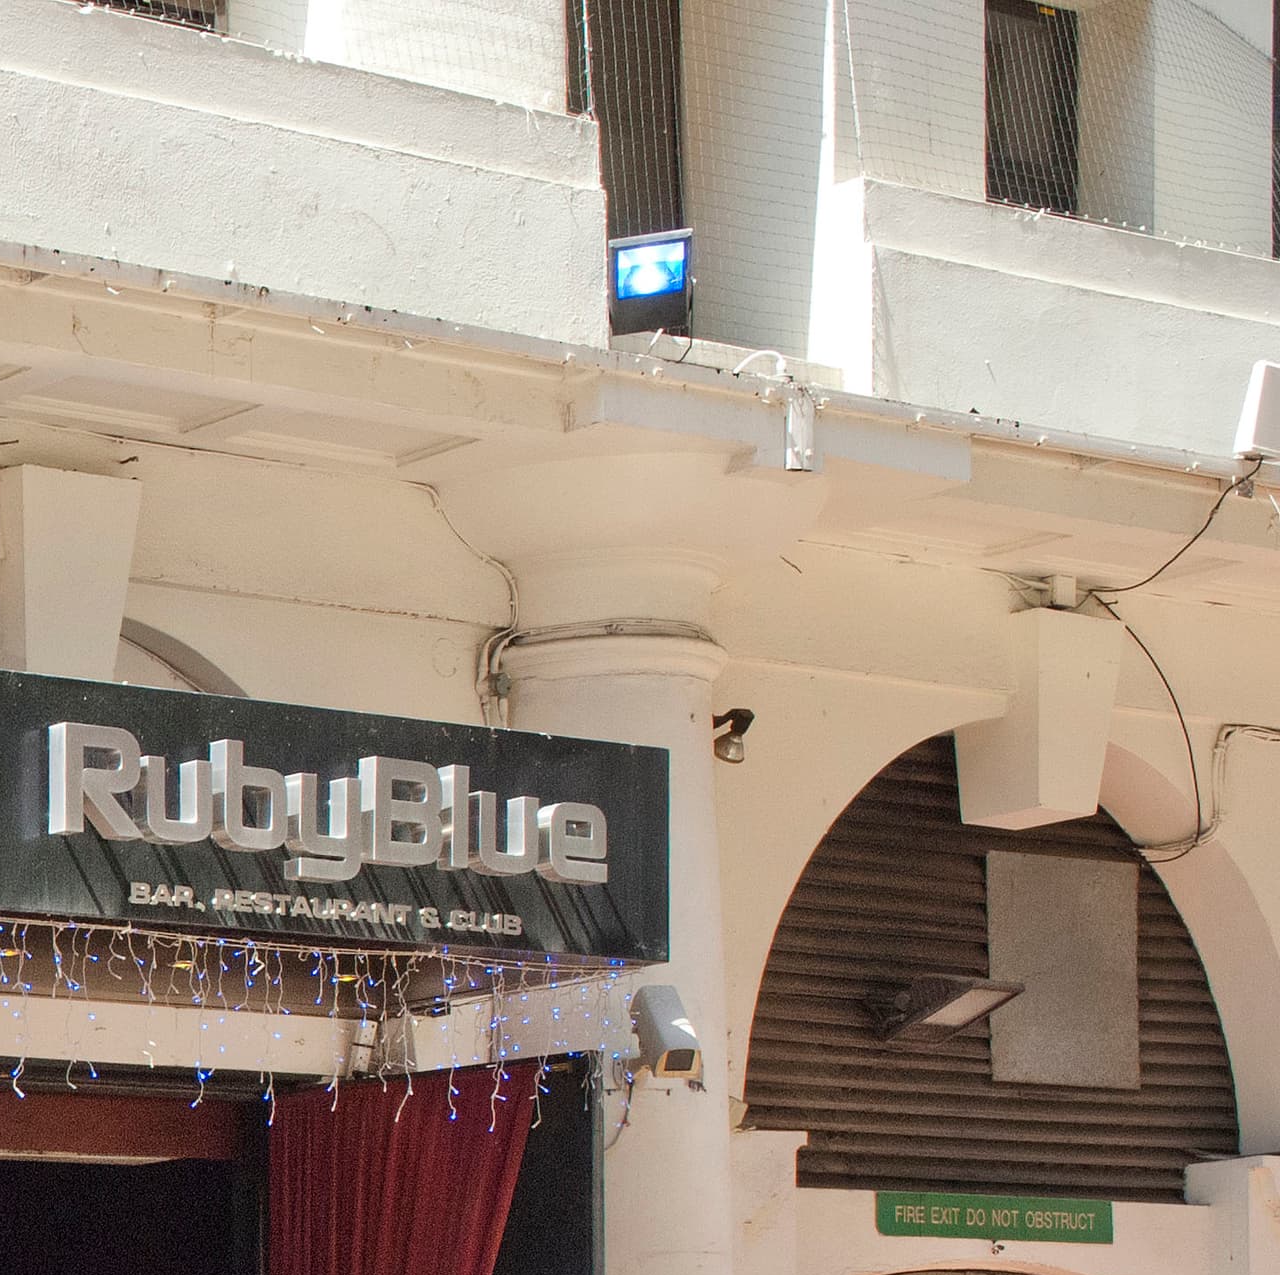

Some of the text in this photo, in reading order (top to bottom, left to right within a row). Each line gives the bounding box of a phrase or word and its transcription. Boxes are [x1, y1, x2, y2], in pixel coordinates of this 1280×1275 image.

[48, 721, 608, 883] RubyBlue
[129, 882, 522, 935] BAR, RESTAURANT & CLUB
[895, 1205, 1096, 1230] FIRE EXIT DO NOT OBSTRUCT
